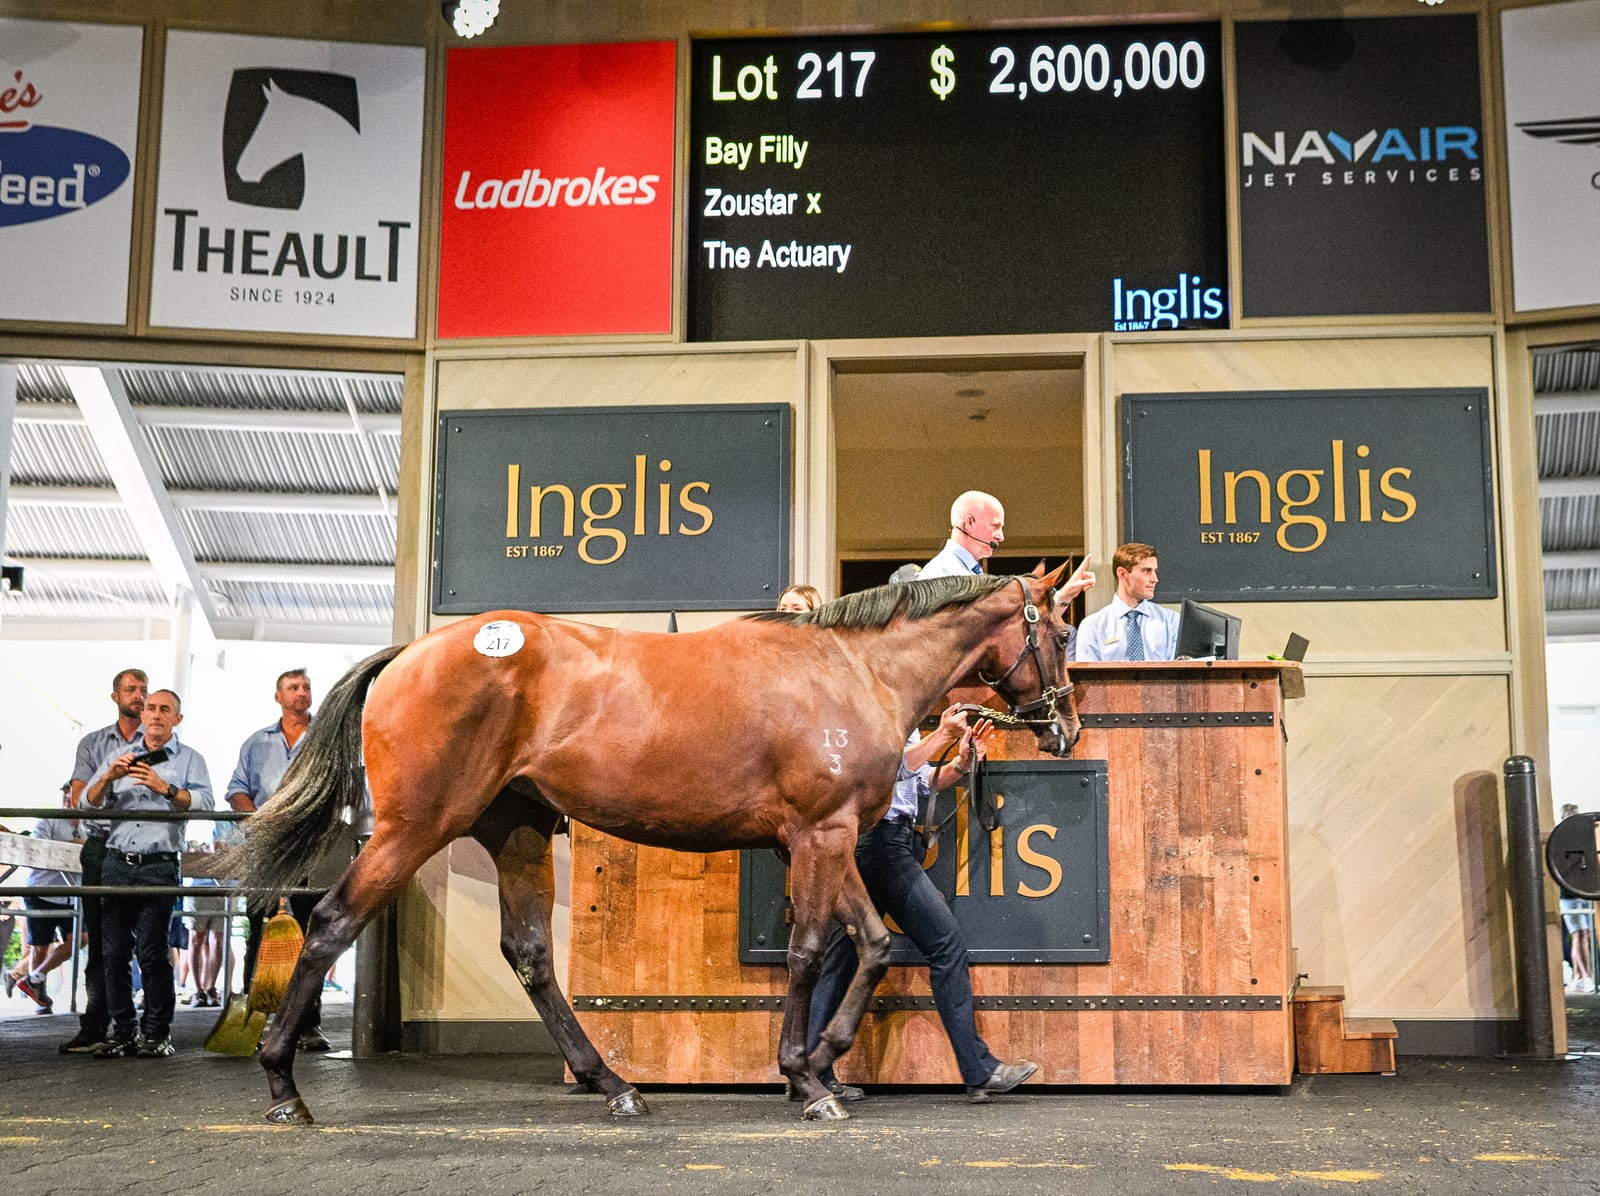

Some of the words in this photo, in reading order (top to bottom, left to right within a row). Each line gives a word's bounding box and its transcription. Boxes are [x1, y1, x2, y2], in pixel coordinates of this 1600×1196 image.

[712, 55, 778, 101] Lot
[796, 51, 876, 99] 217
[929, 44, 956, 101] $
[988, 41, 1206, 100] 2,600,000
[705, 136, 753, 171] Bay
[759, 135, 809, 170] Filly
[1242, 125, 1479, 167] NAVAIR
[0, 162, 87, 209] eed
[454, 166, 660, 210] Ladbrokes
[1244, 172, 1297, 188] JET
[1321, 167, 1482, 186] SERVICES
[703, 188, 799, 217] Zoustar
[805, 192, 822, 215] x
[164, 207, 411, 283] THEAULT
[703, 240, 751, 270] The
[756, 239, 852, 274] Actuary
[230, 286, 283, 304] SINCE
[294, 290, 336, 305] 1924
[1113, 272, 1224, 330] Inglis
[505, 454, 715, 566] Inglis
[1197, 438, 1418, 554] Inglis
[505, 545, 530, 559] EST
[532, 544, 565, 558] 1867
[1200, 531, 1225, 544] EST
[1227, 531, 1262, 545] 1867
[486, 637, 511, 650] 217
[822, 728, 849, 748] 13
[828, 753, 842, 776] 3
